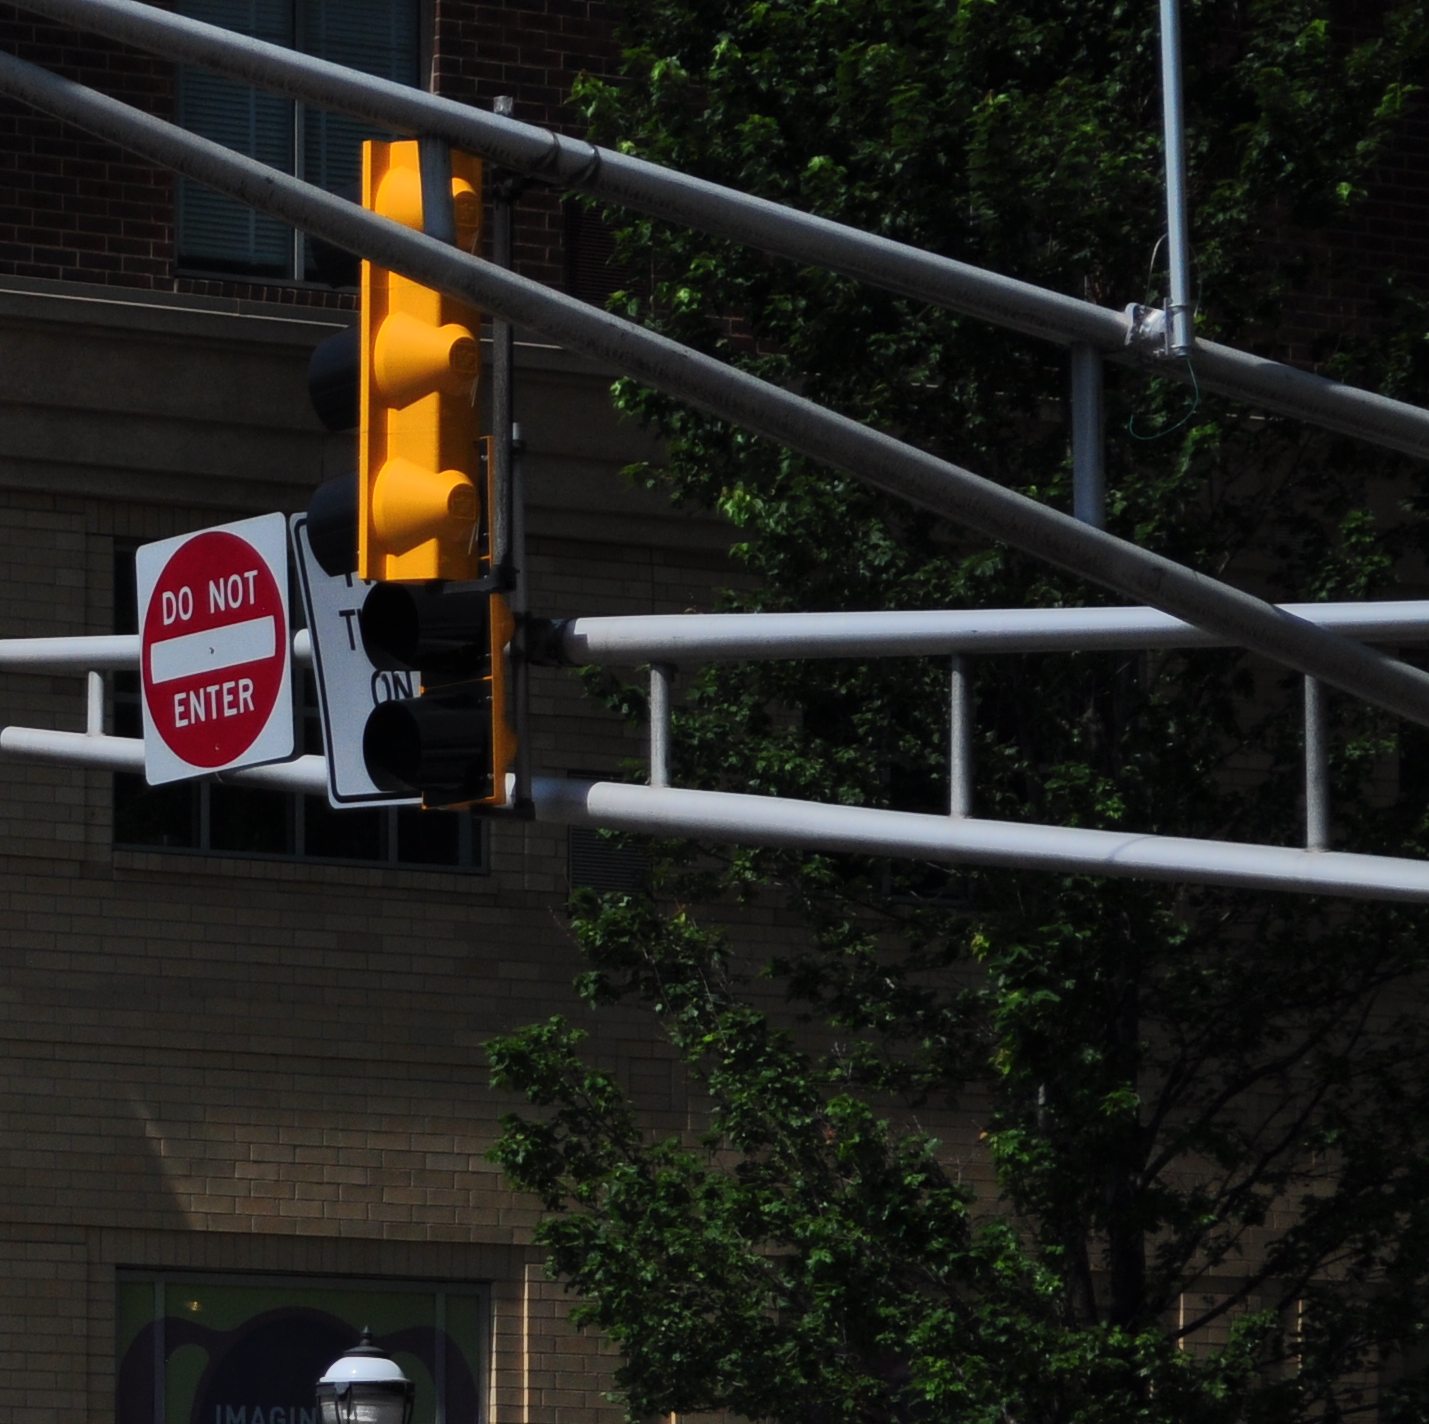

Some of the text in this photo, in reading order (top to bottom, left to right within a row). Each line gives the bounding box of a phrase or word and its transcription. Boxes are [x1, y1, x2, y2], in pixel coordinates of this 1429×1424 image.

[161, 569, 259, 627] DO NOT
[172, 677, 255, 730] ENTER
